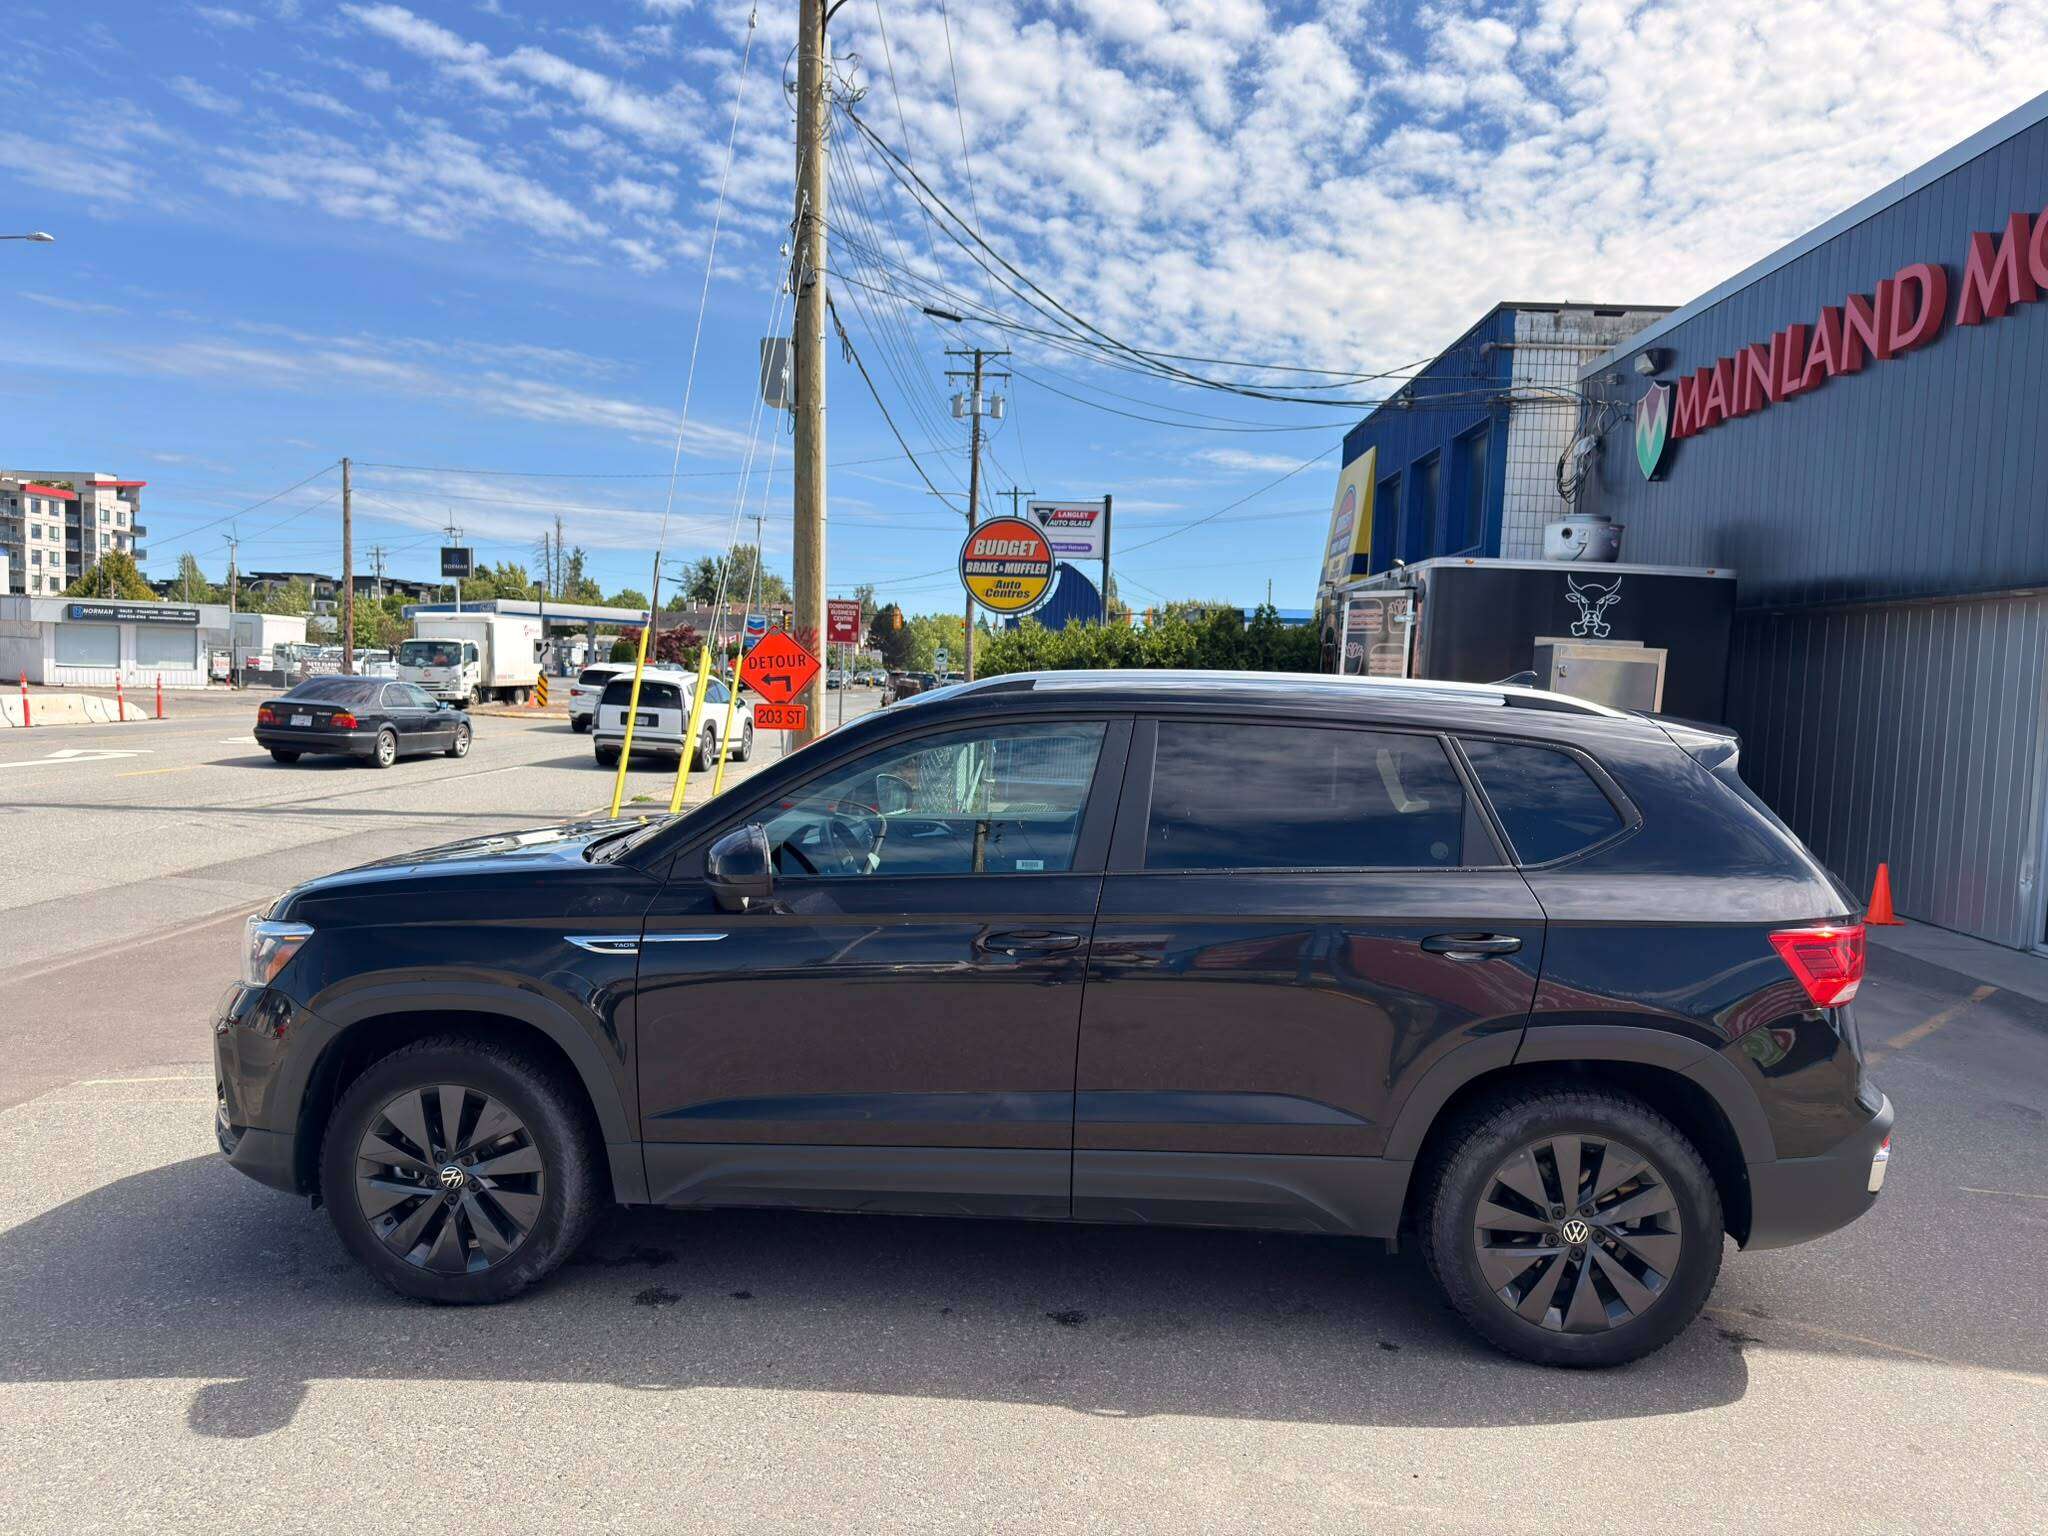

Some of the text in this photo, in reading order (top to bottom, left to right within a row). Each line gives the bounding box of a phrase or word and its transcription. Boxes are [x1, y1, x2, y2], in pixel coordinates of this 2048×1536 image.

[1672, 263, 1947, 439] MAINLAND
[973, 539, 1039, 557] BUDGET
[965, 561, 999, 574] BRAKE
[1004, 562, 1048, 575] MUFFLER
[995, 580, 1022, 589] Auto
[984, 588, 1030, 599] Centres
[83, 607, 114, 615] NORMAN
[748, 655, 807, 670] DETOUR
[758, 710, 802, 724] 203 ST
